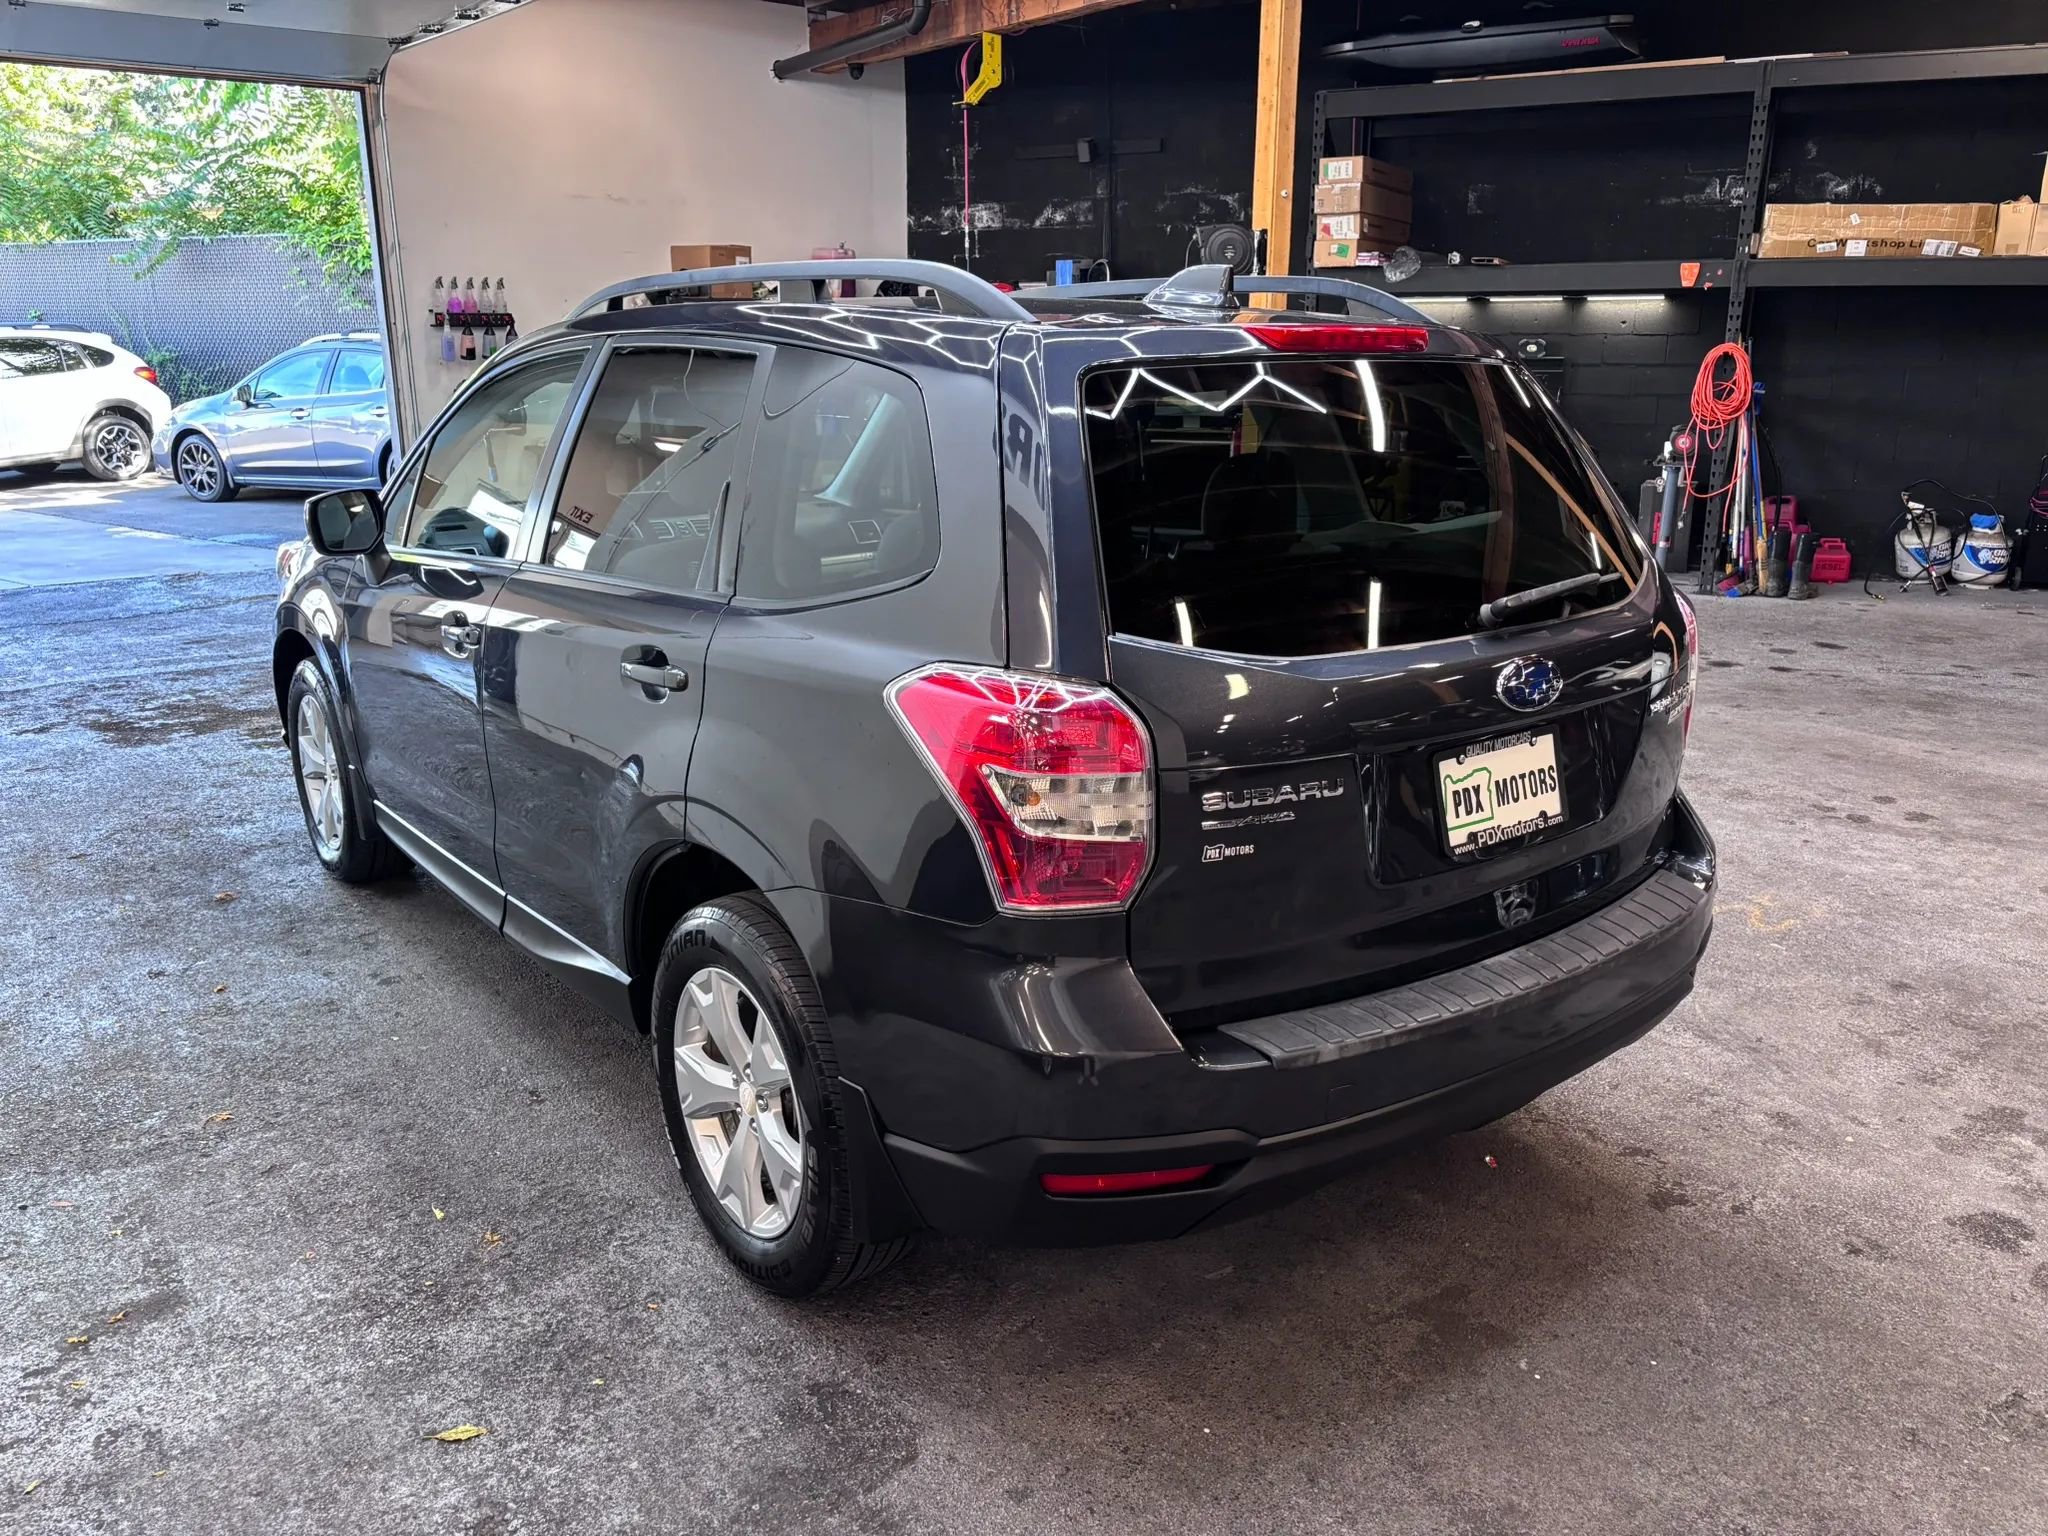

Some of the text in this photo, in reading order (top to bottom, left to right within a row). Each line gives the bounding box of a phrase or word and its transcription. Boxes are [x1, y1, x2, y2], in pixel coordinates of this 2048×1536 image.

[1466, 731, 1531, 757] QUALITY MOTORCARS
[1201, 778, 1344, 812] SUBARU
[1452, 765, 1557, 819] PDX MOTORS
[1206, 845, 1255, 859] PDX MOTORS
[1454, 815, 1563, 855] www.PDXmotors.com
